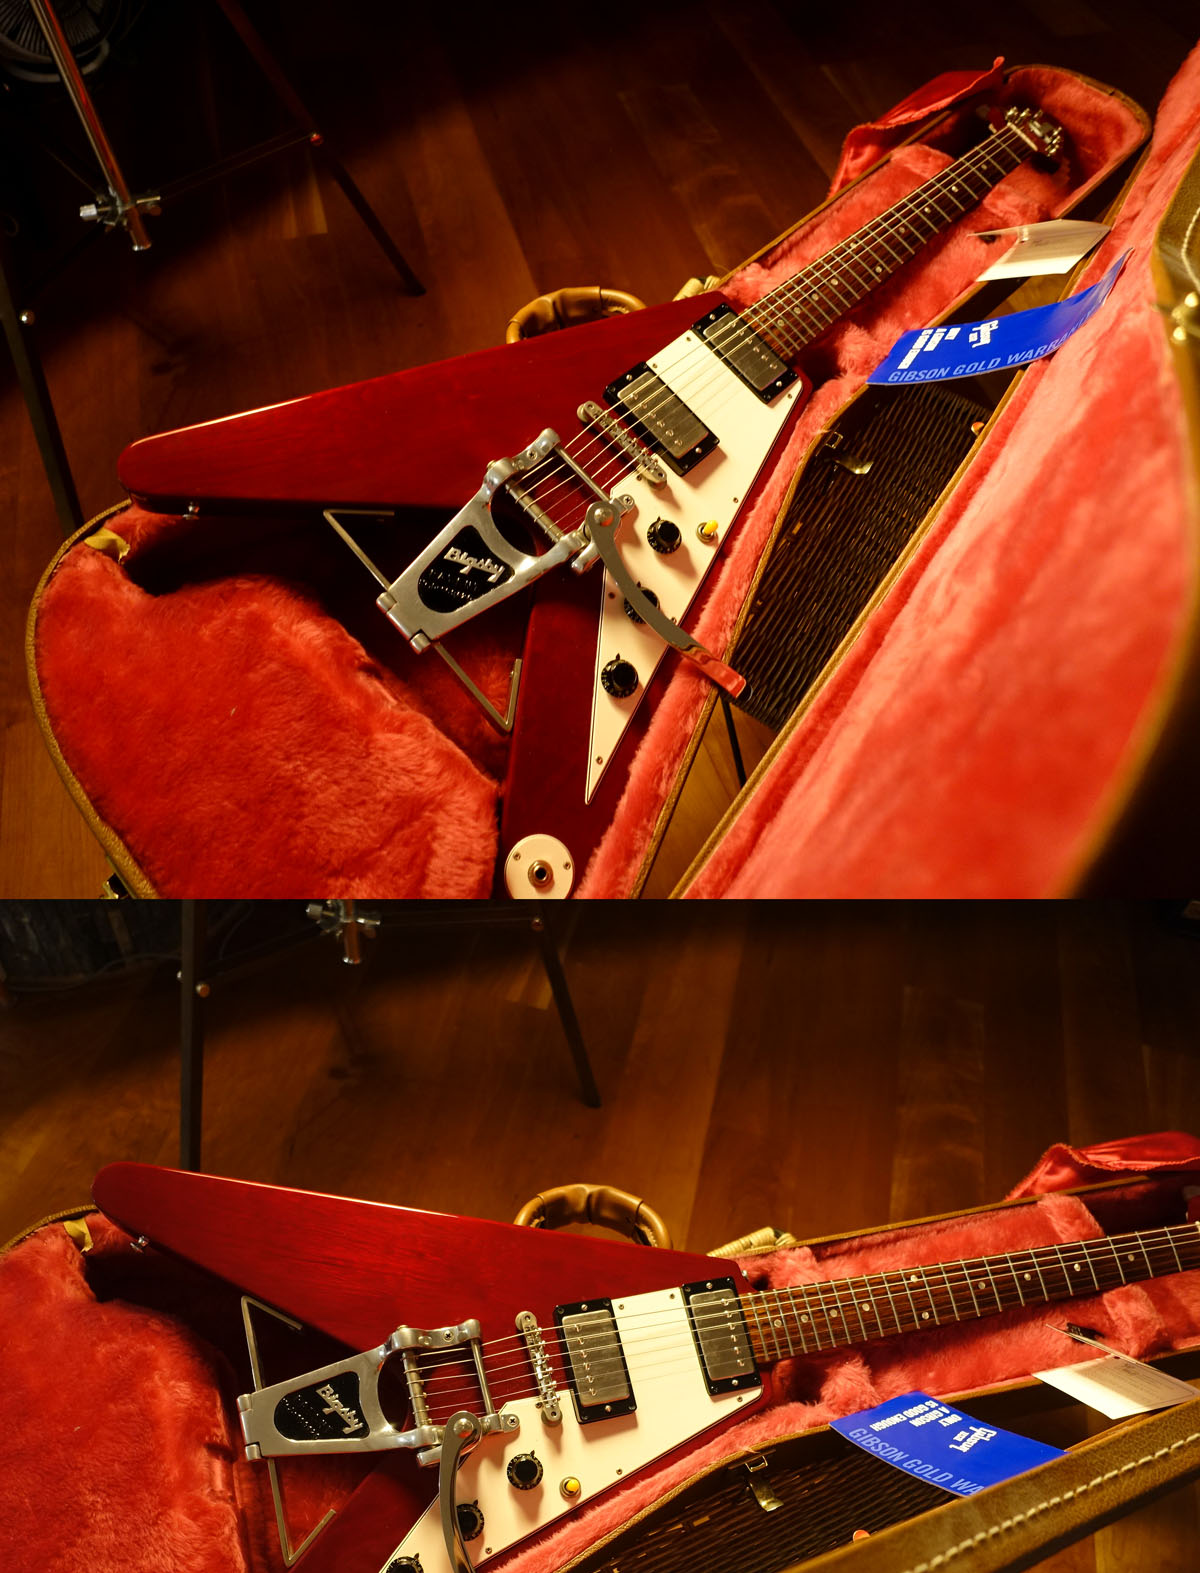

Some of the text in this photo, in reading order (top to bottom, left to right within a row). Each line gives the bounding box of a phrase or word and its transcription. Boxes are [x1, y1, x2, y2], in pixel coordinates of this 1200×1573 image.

[888, 366, 951, 382] GIBSON
[953, 356, 1000, 376] GOLD
[443, 546, 505, 583] Bigsby
[316, 1383, 364, 1435] Bigsby
[848, 1428, 909, 1462] GIBSON
[902, 1459, 954, 1484] GOLD
